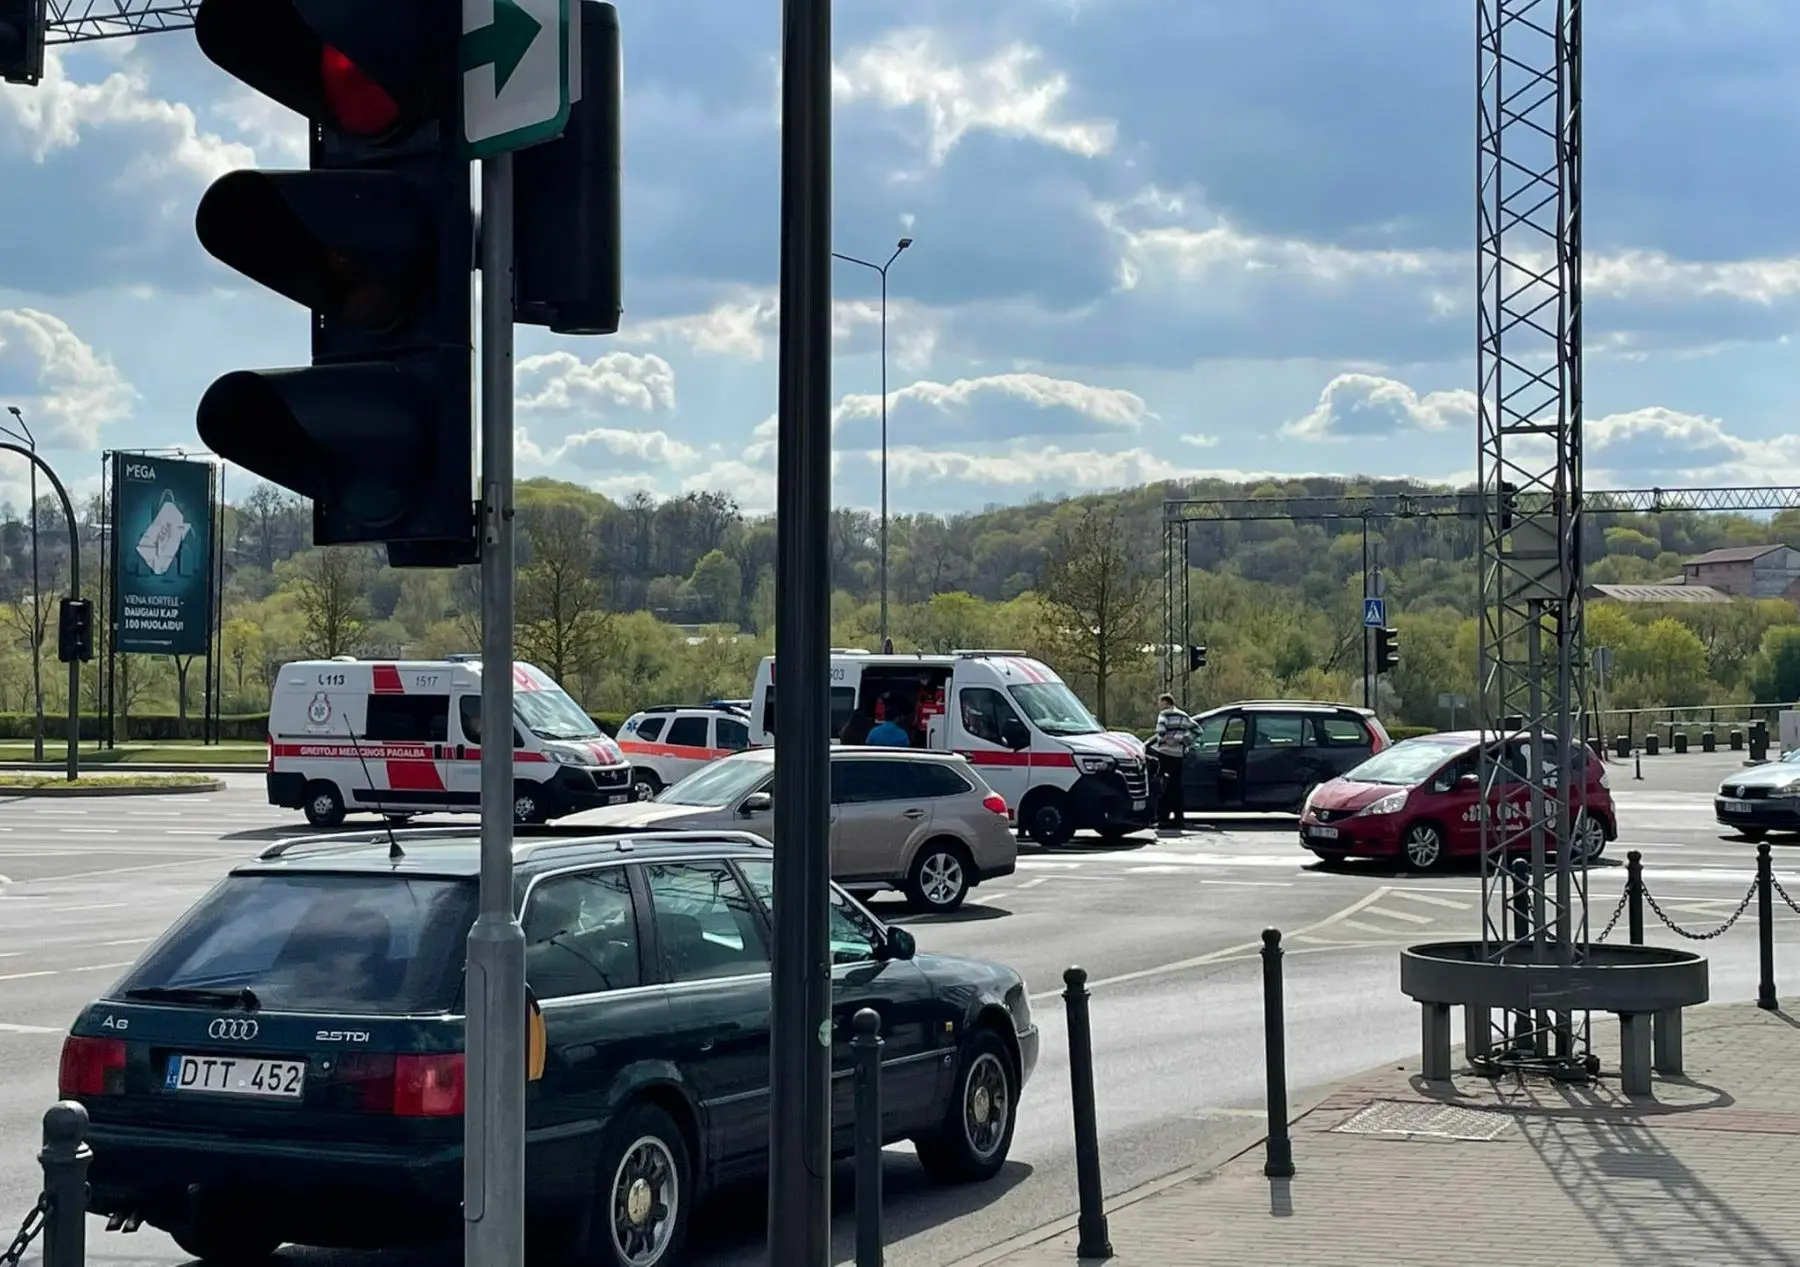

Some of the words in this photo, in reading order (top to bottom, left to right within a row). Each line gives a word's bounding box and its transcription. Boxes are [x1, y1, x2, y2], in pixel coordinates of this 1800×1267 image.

[126, 464, 156, 480] MEGA
[124, 607, 159, 617] DAUGIAU
[160, 608, 179, 618] KAIP
[125, 619, 140, 630] 100
[327, 674, 345, 686] 113
[415, 676, 439, 688] 1517
[300, 746, 338, 756] GREITOJI
[339, 747, 385, 757] MEDCINOS
[386, 748, 425, 758] PAGALBA
[102, 1015, 129, 1030] A6
[181, 1059, 236, 1086] DTT
[250, 1062, 300, 1092] 452
